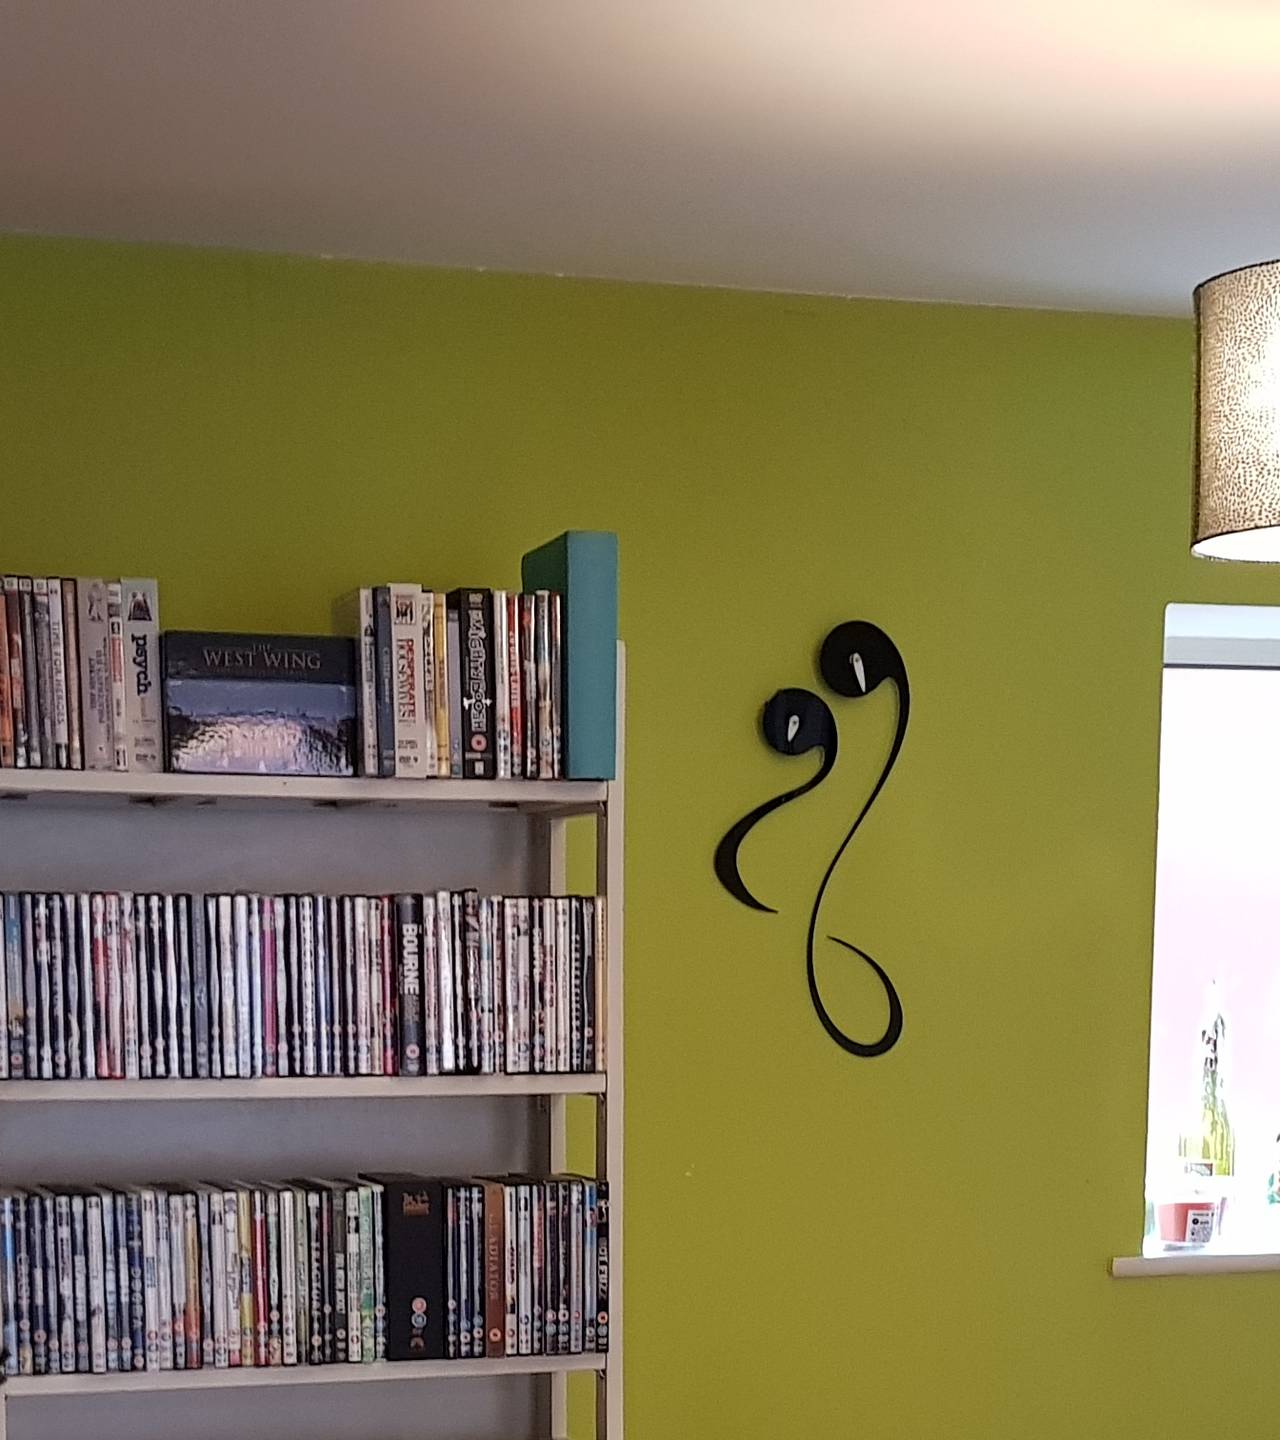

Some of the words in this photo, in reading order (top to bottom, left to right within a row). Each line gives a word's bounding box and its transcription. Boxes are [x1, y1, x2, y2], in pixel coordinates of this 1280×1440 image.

[131, 634, 152, 698] psych
[203, 648, 254, 667] WEST
[264, 650, 322, 669] WING
[406, 638, 417, 719] DESPERATE
[402, 922, 420, 997] BOURNE
